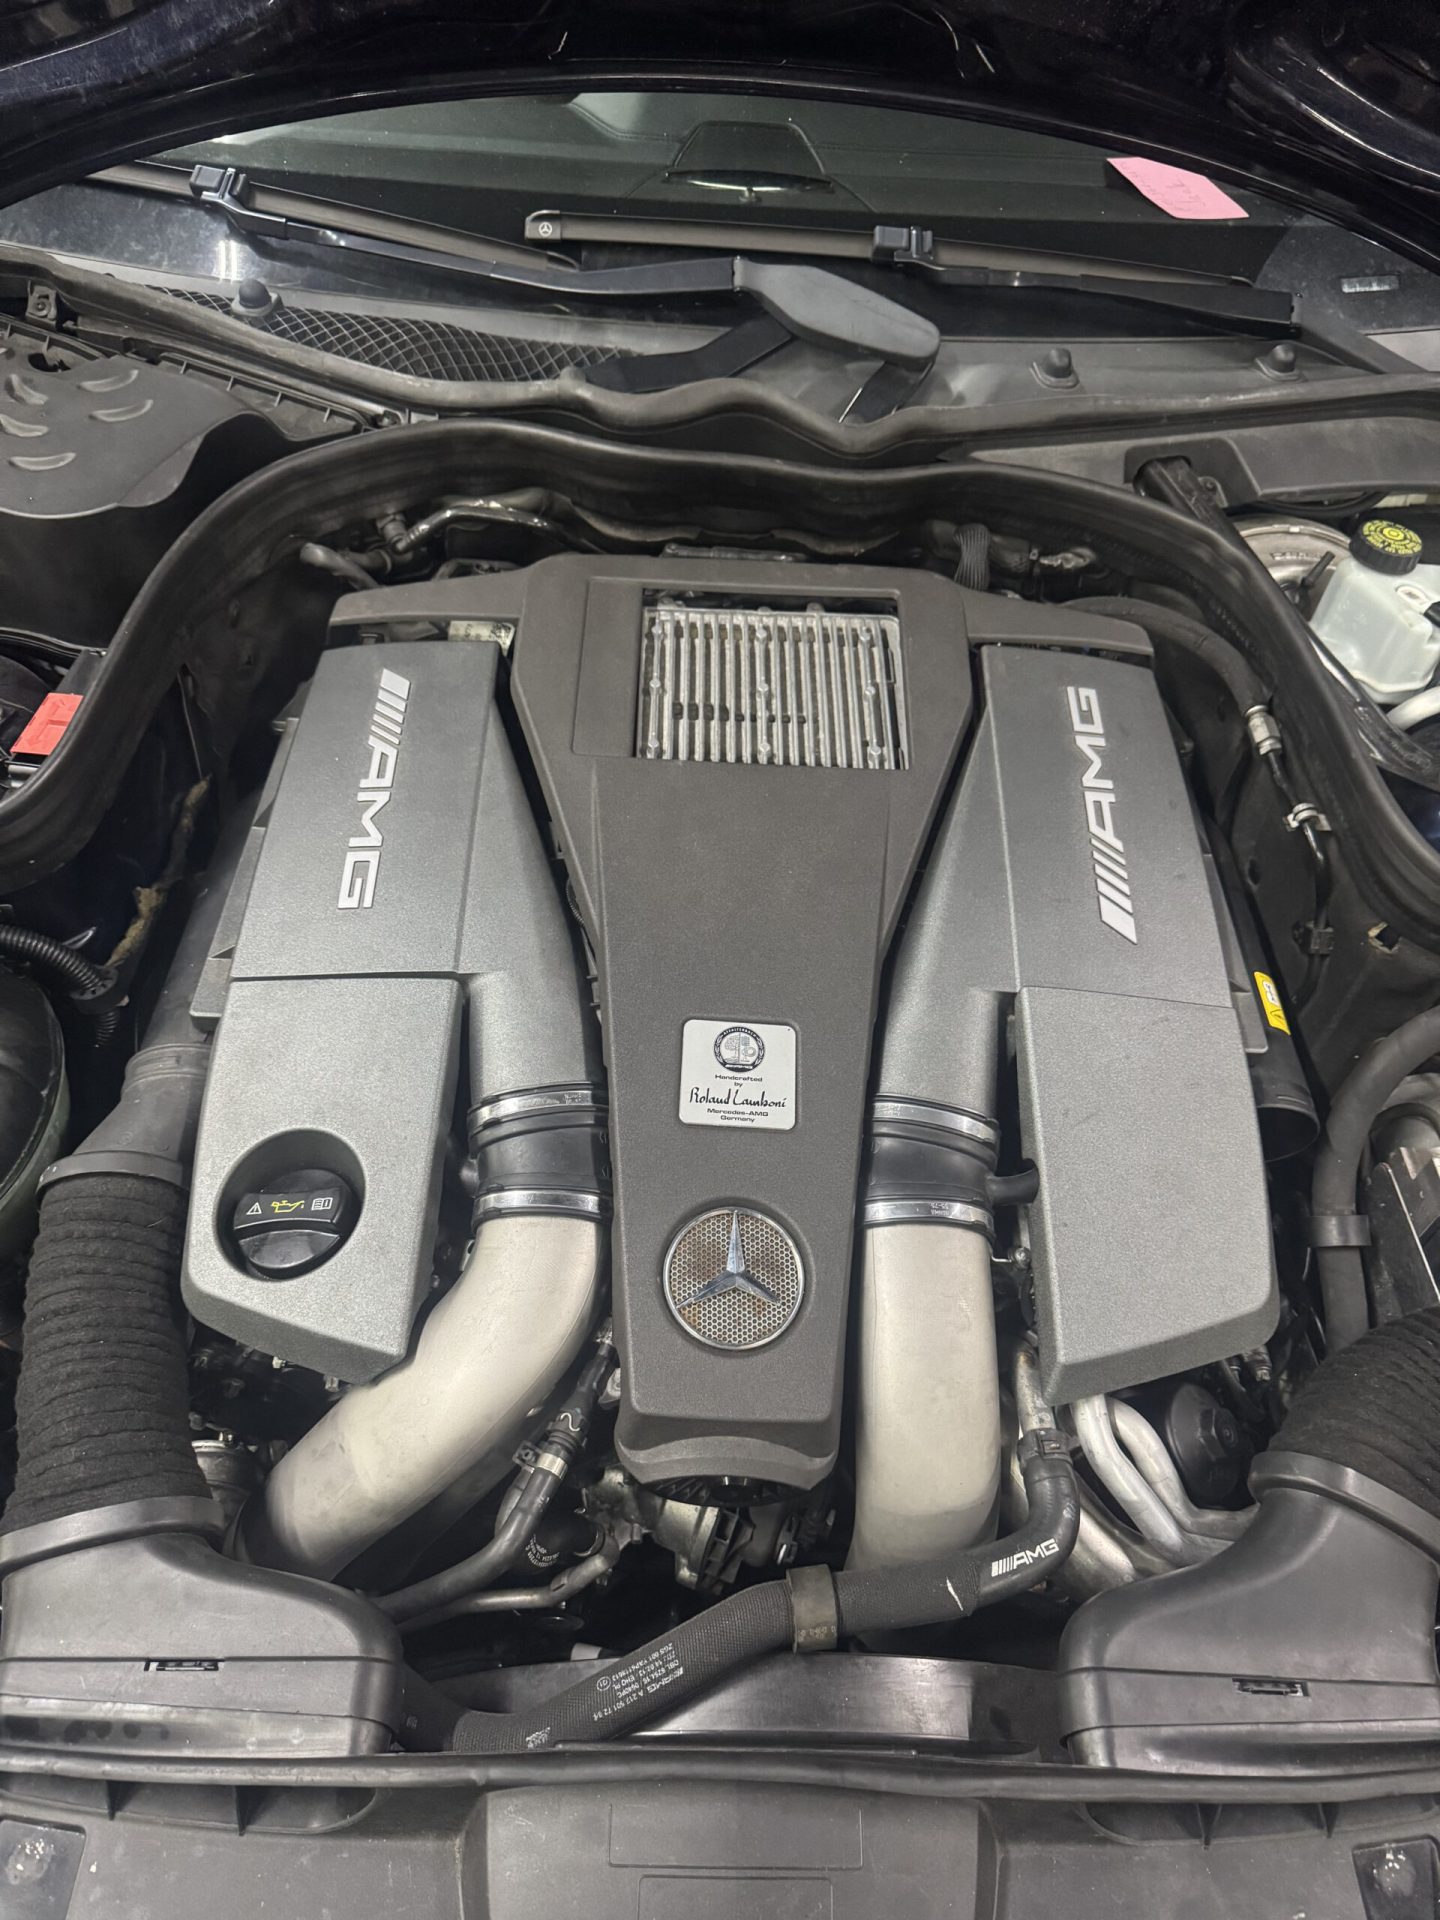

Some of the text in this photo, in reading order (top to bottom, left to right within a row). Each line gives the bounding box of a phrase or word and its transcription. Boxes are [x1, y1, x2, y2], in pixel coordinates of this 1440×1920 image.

[1066, 686, 1124, 853] AMG
[337, 736, 399, 909] AMG
[715, 1074, 763, 1082] Handcrafted
[707, 1108, 769, 1117] Mercedes-AMG
[720, 1115, 755, 1123] Germany
[1013, 1538, 1060, 1570] AMG
